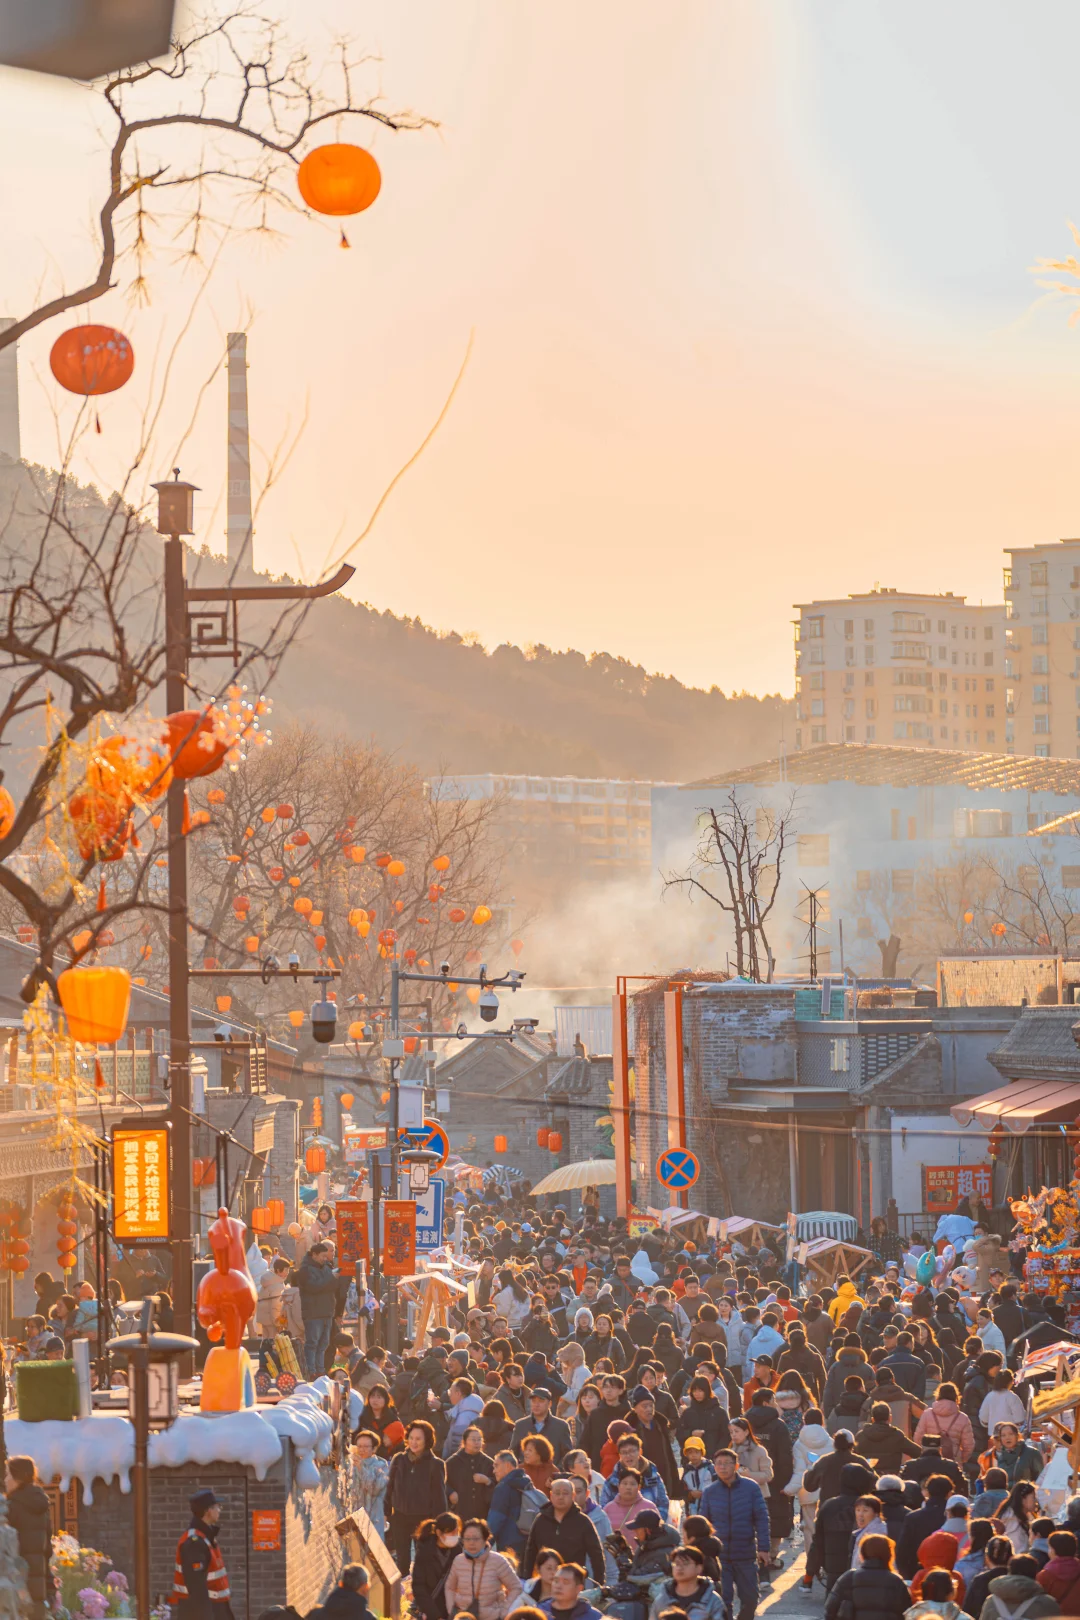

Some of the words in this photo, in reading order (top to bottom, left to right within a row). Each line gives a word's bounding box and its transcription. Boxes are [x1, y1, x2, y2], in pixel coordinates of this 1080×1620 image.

[144, 1140, 160, 1222] 春回大地花开放
[957, 1169, 991, 1197] 超市
[389, 1220, 411, 1264] 古道迎春
